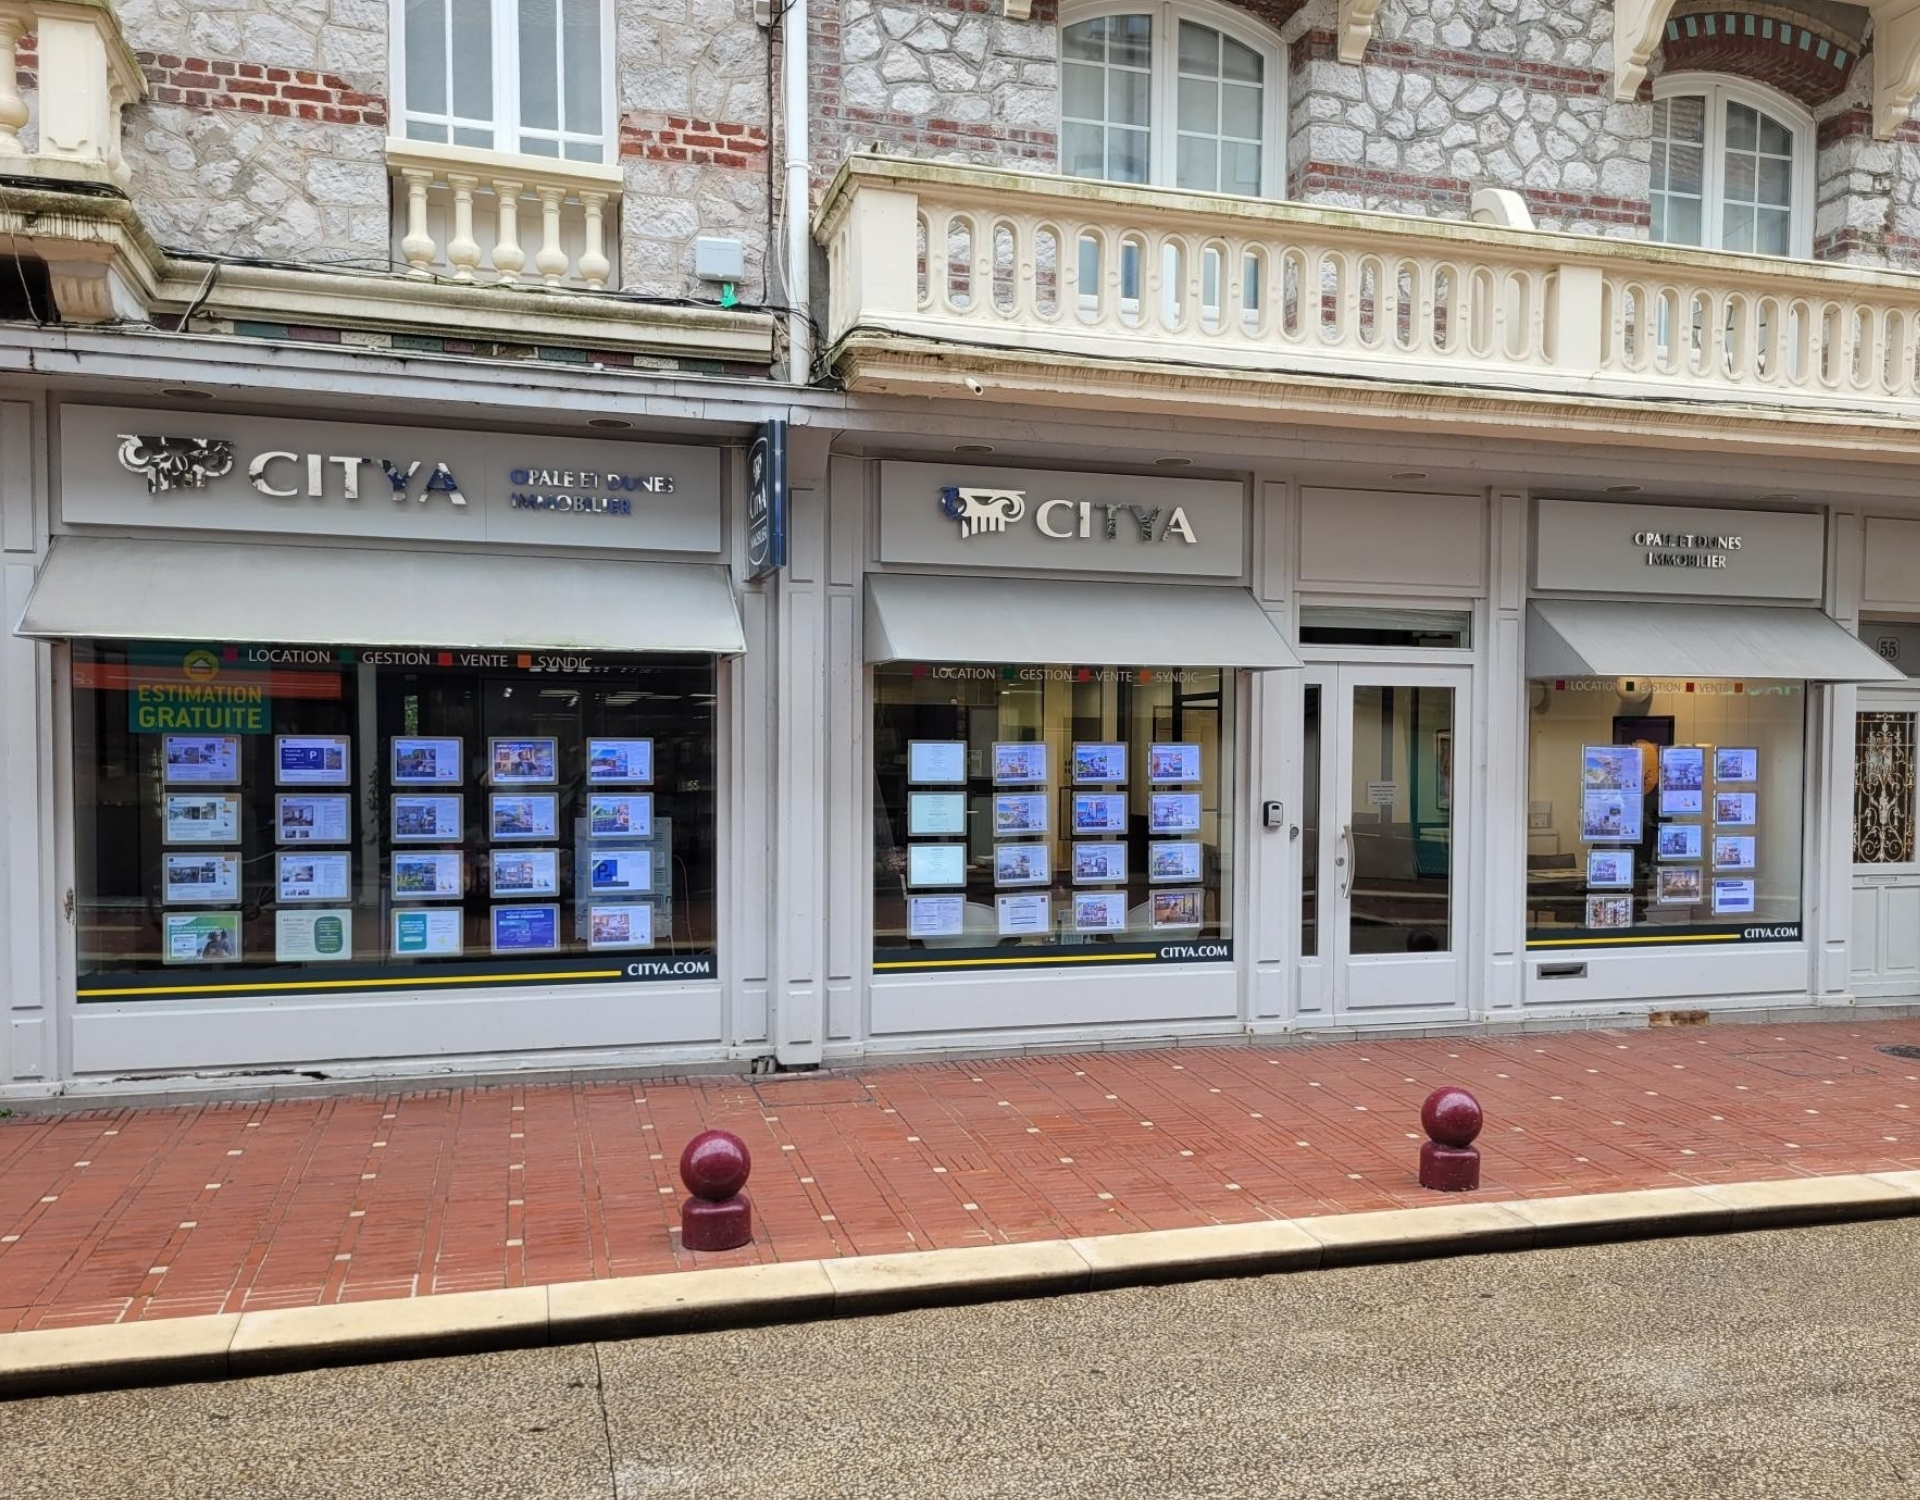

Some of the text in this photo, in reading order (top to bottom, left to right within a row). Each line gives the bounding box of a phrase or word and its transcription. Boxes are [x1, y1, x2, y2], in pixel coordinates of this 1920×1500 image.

[249, 451, 467, 505] CITYA
[510, 468, 674, 494] OPALE ET DUNES
[510, 492, 632, 515] IMMOBILIER
[1036, 499, 1198, 543] CITYA
[1634, 532, 1742, 550] OPALE ET DUNES
[1647, 552, 1727, 569] IMMOBILIER
[1880, 640, 1897, 658] 55
[248, 649, 592, 669] LOCATION GESTION VENTE SYNDIC
[932, 667, 1198, 683] LOCATION GESTION VENTE SYNDIC
[137, 684, 263, 704] ESTIMATION
[137, 706, 263, 729] GRATUITE
[1744, 927, 1798, 939] CITYA.COM
[1160, 945, 1228, 958] CITYA.COM
[627, 961, 710, 976] CITYA.COM
